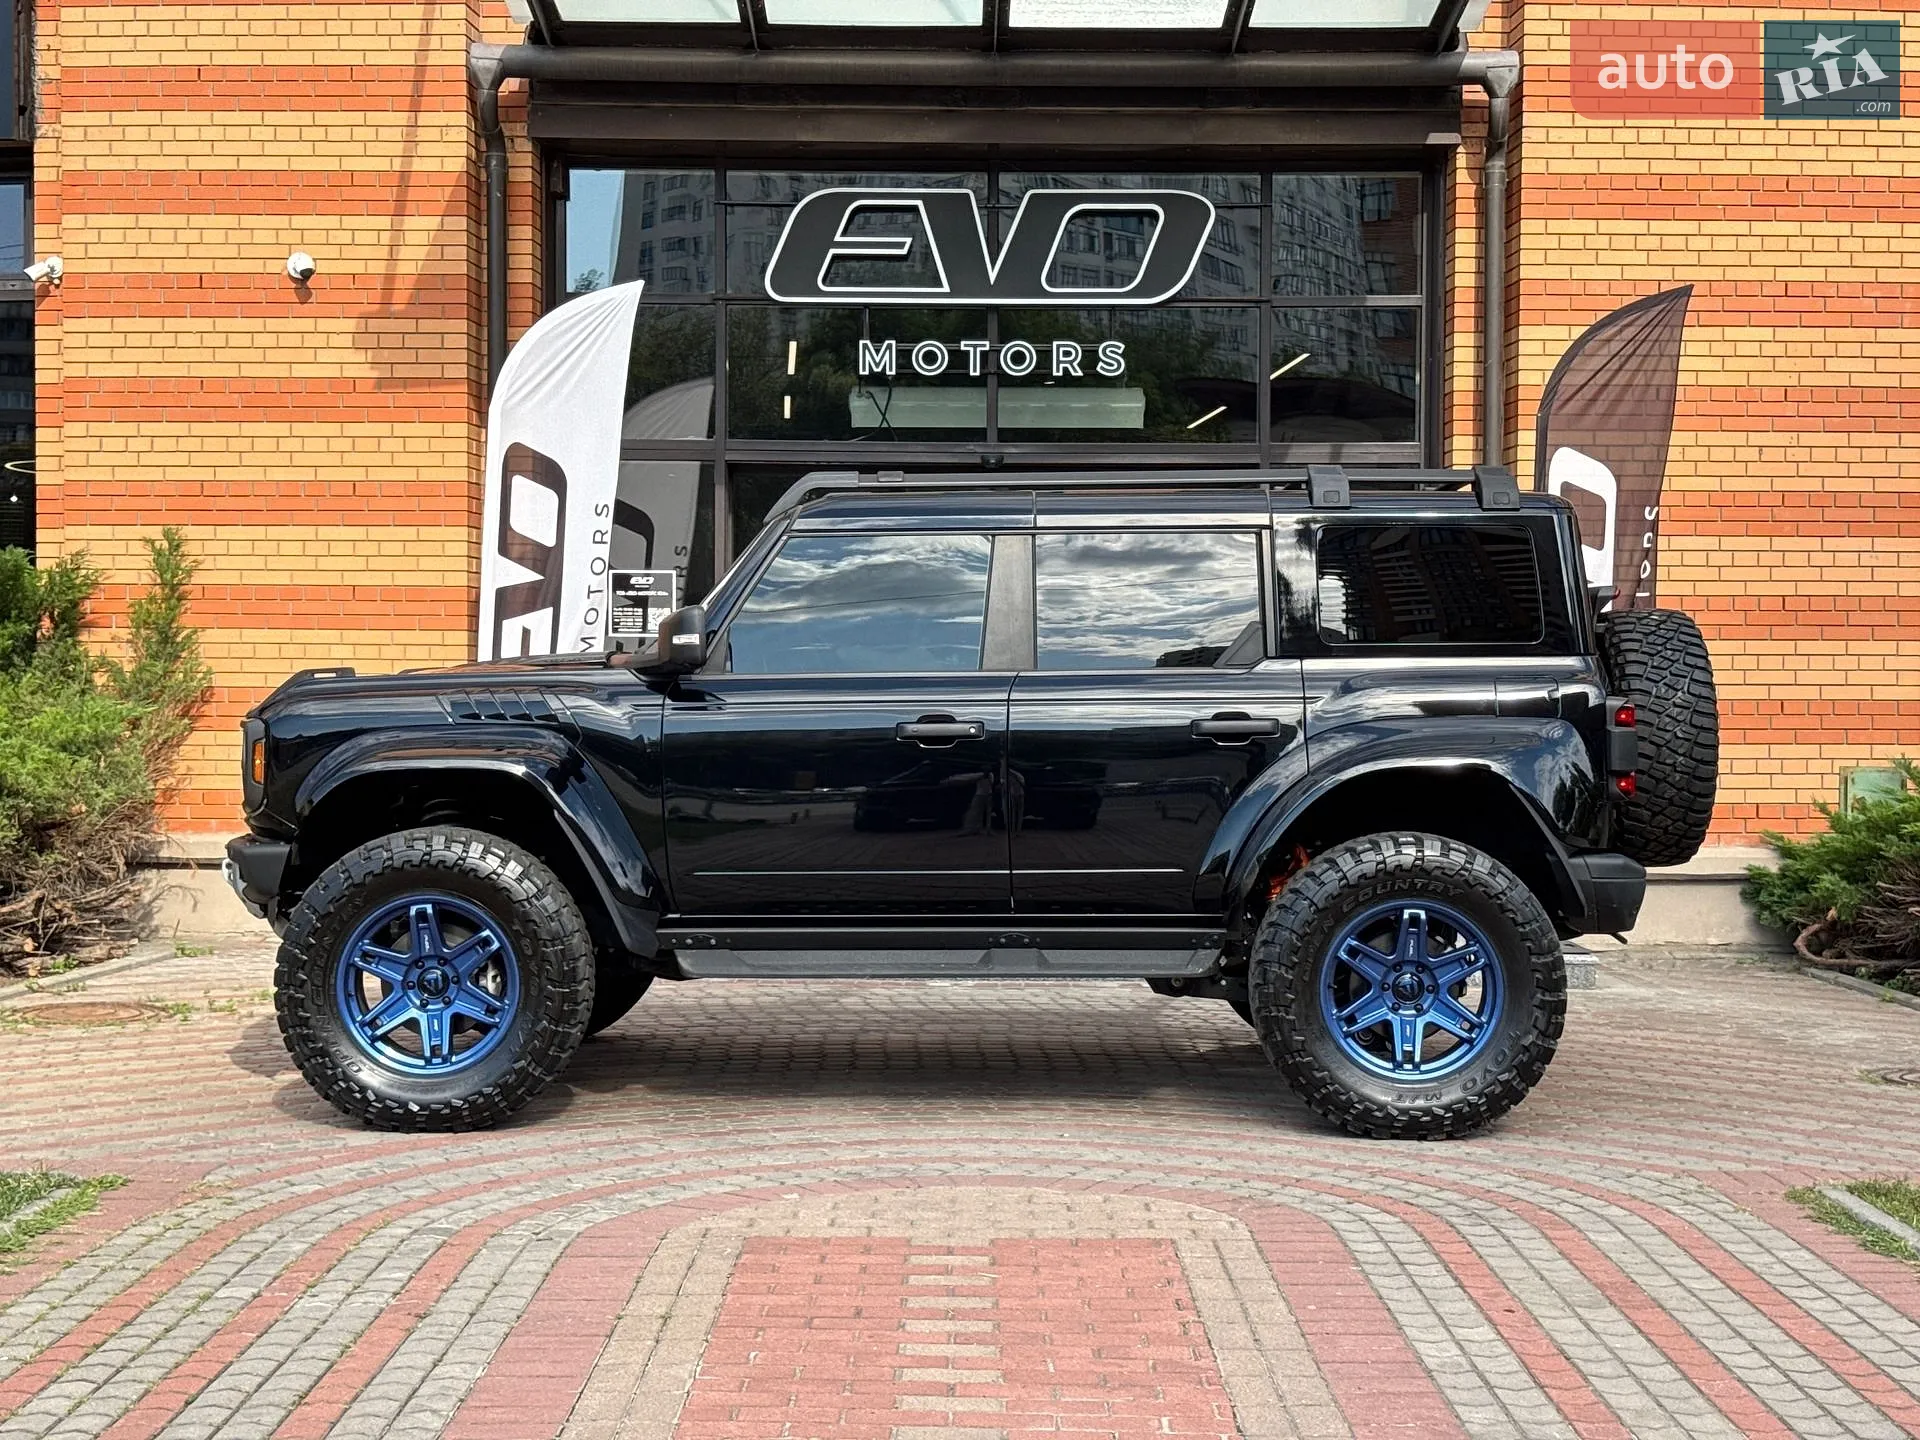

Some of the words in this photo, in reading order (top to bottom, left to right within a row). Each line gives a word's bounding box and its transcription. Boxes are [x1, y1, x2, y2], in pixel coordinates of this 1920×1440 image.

[764, 187, 1216, 305] EVO
[858, 340, 1126, 376] MOTORS
[580, 503, 610, 652] MOTORS
[1342, 879, 1464, 912] COUNTRY
